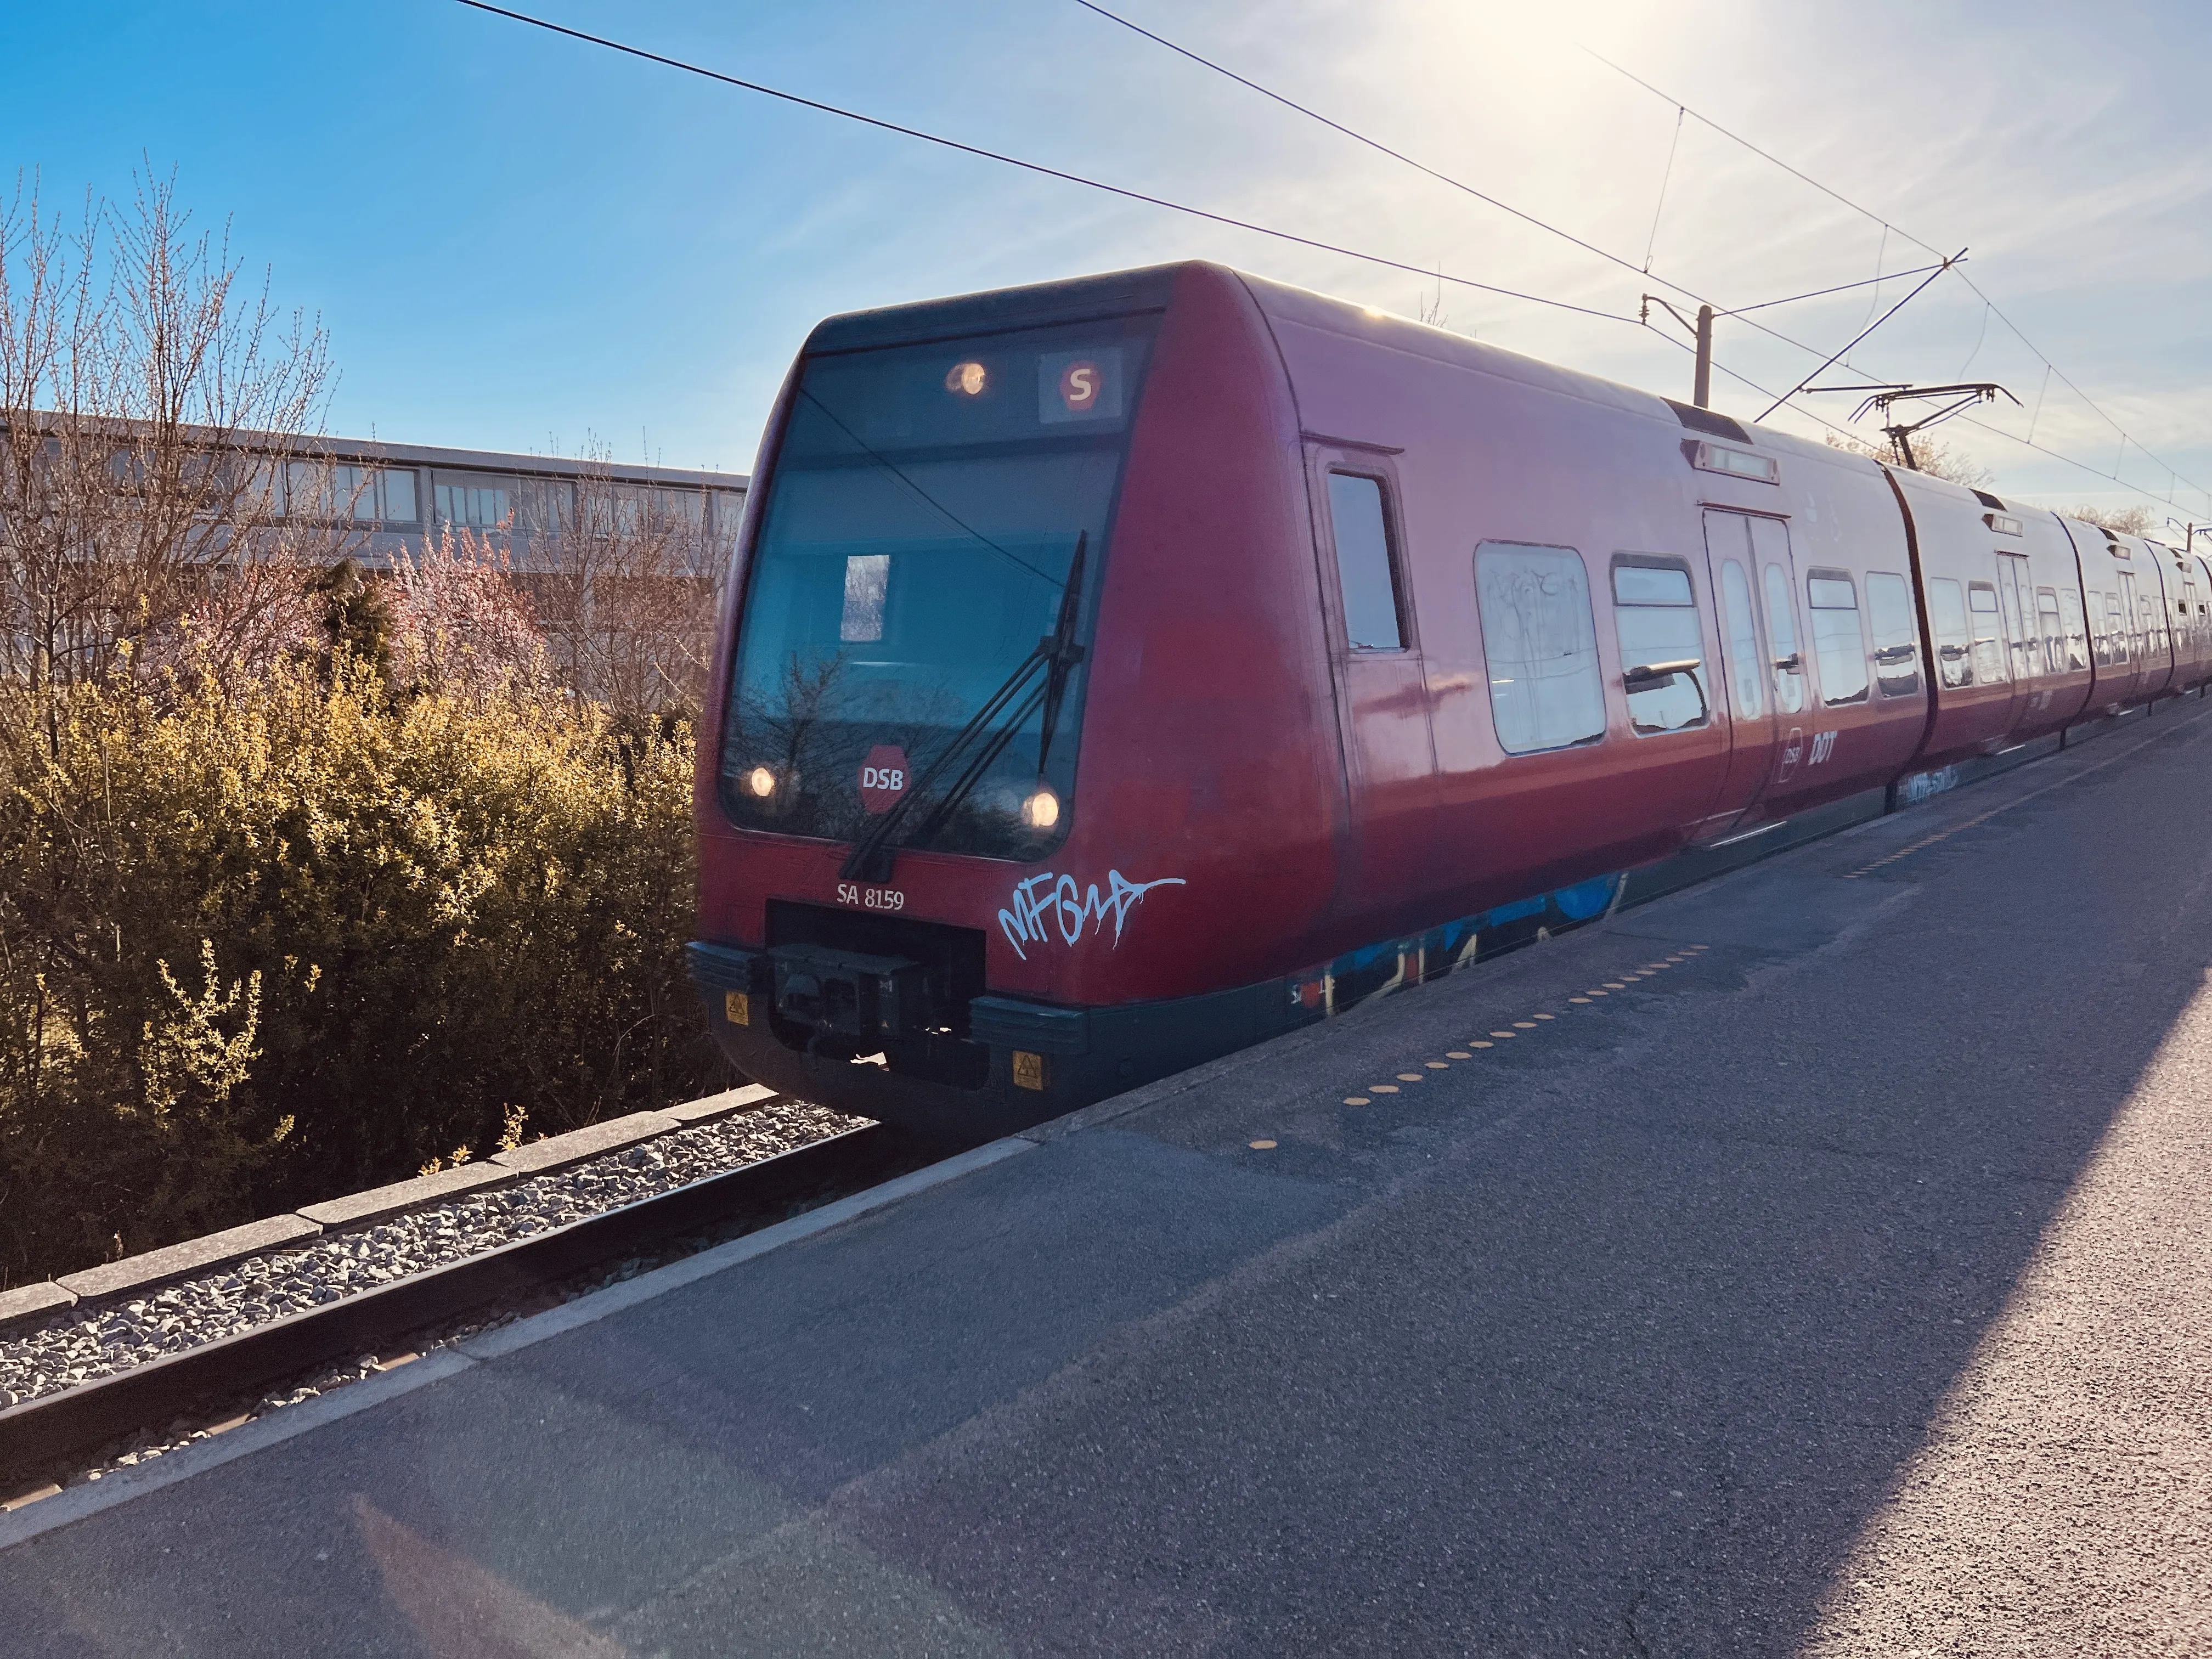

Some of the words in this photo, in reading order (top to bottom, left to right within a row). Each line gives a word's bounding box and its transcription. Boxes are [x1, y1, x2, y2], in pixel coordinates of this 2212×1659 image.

[1070, 368, 1092, 401] S
[863, 767, 904, 791] DSB
[837, 883, 859, 905] SA
[865, 888, 905, 910] 8159
